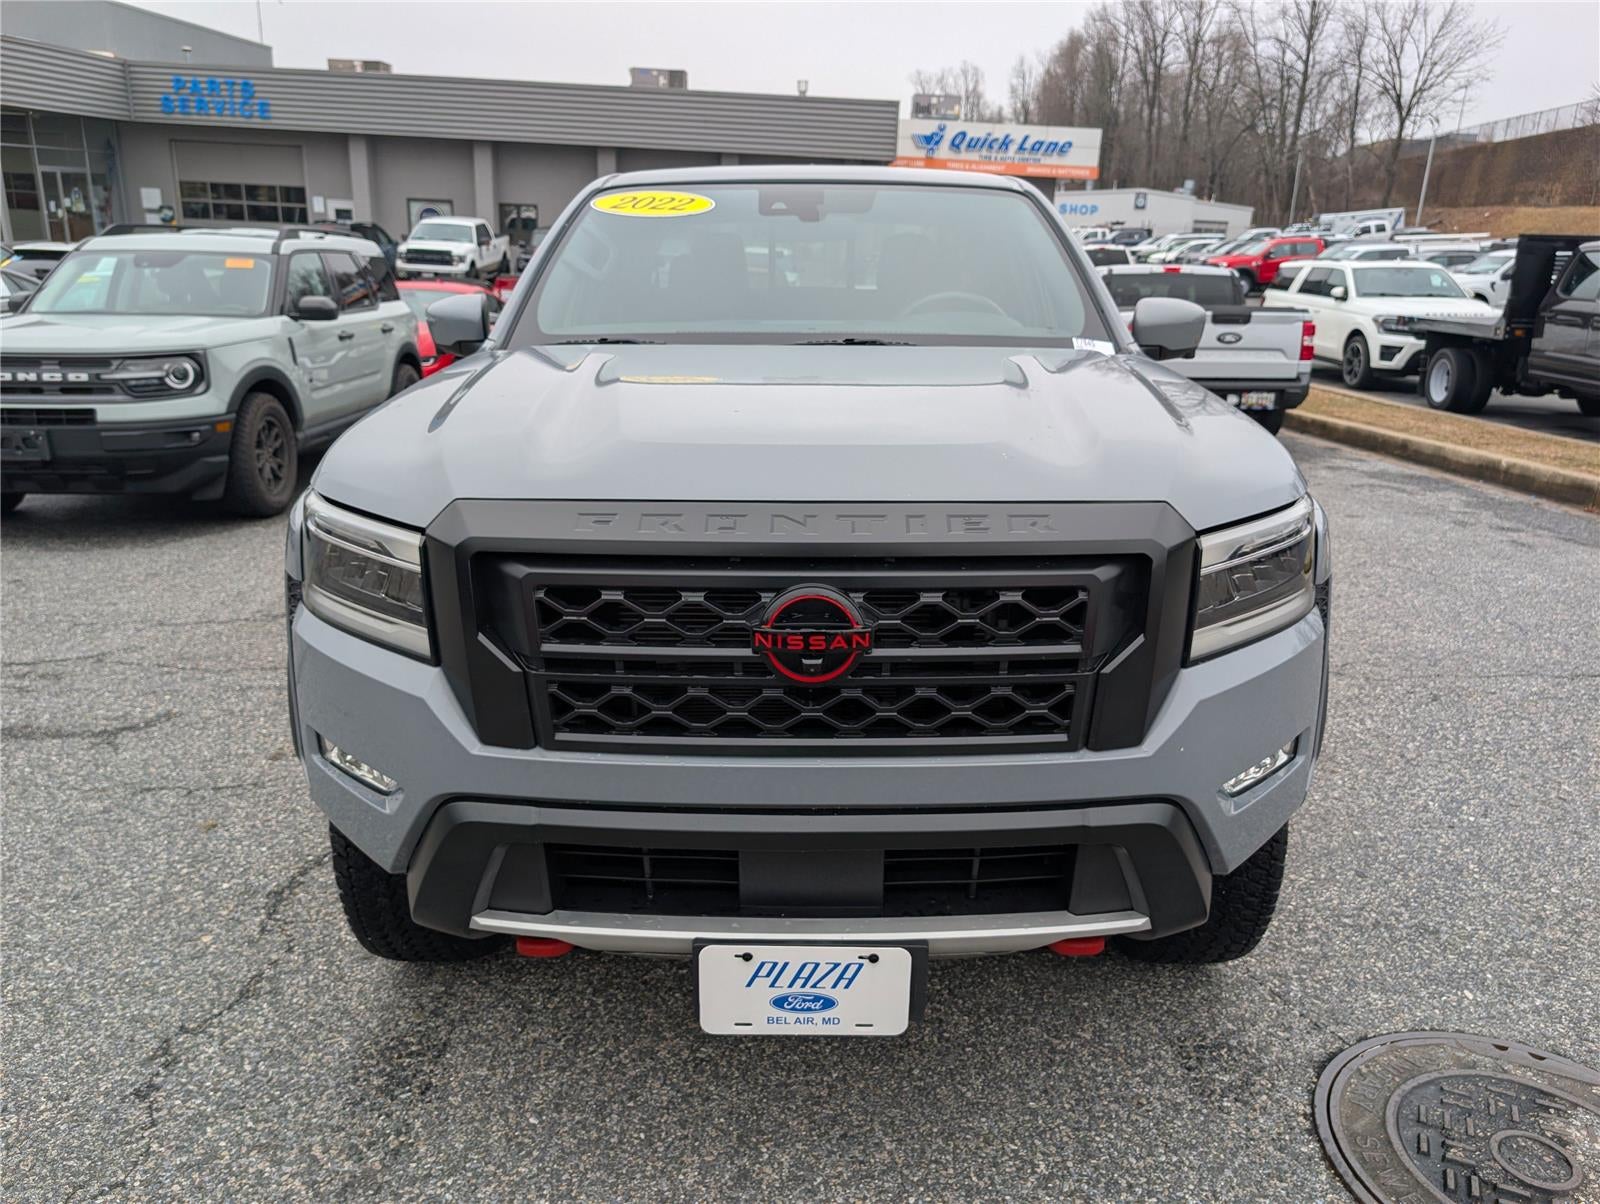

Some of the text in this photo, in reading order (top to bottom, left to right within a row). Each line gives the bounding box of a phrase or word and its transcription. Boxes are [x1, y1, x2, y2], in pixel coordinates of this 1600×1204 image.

[171, 75, 255, 99] PARTS
[160, 93, 272, 119] SERVICE
[950, 131, 1074, 157] Quick Lane
[608, 196, 695, 211] 2022
[1059, 203, 1099, 216] SHOP
[573, 512, 1058, 535] FRONTIER
[753, 632, 872, 651] NISSAN
[745, 960, 864, 990] PLAZA
[783, 994, 824, 1010] Ford
[766, 1016, 841, 1026] BEL AIR, MD
